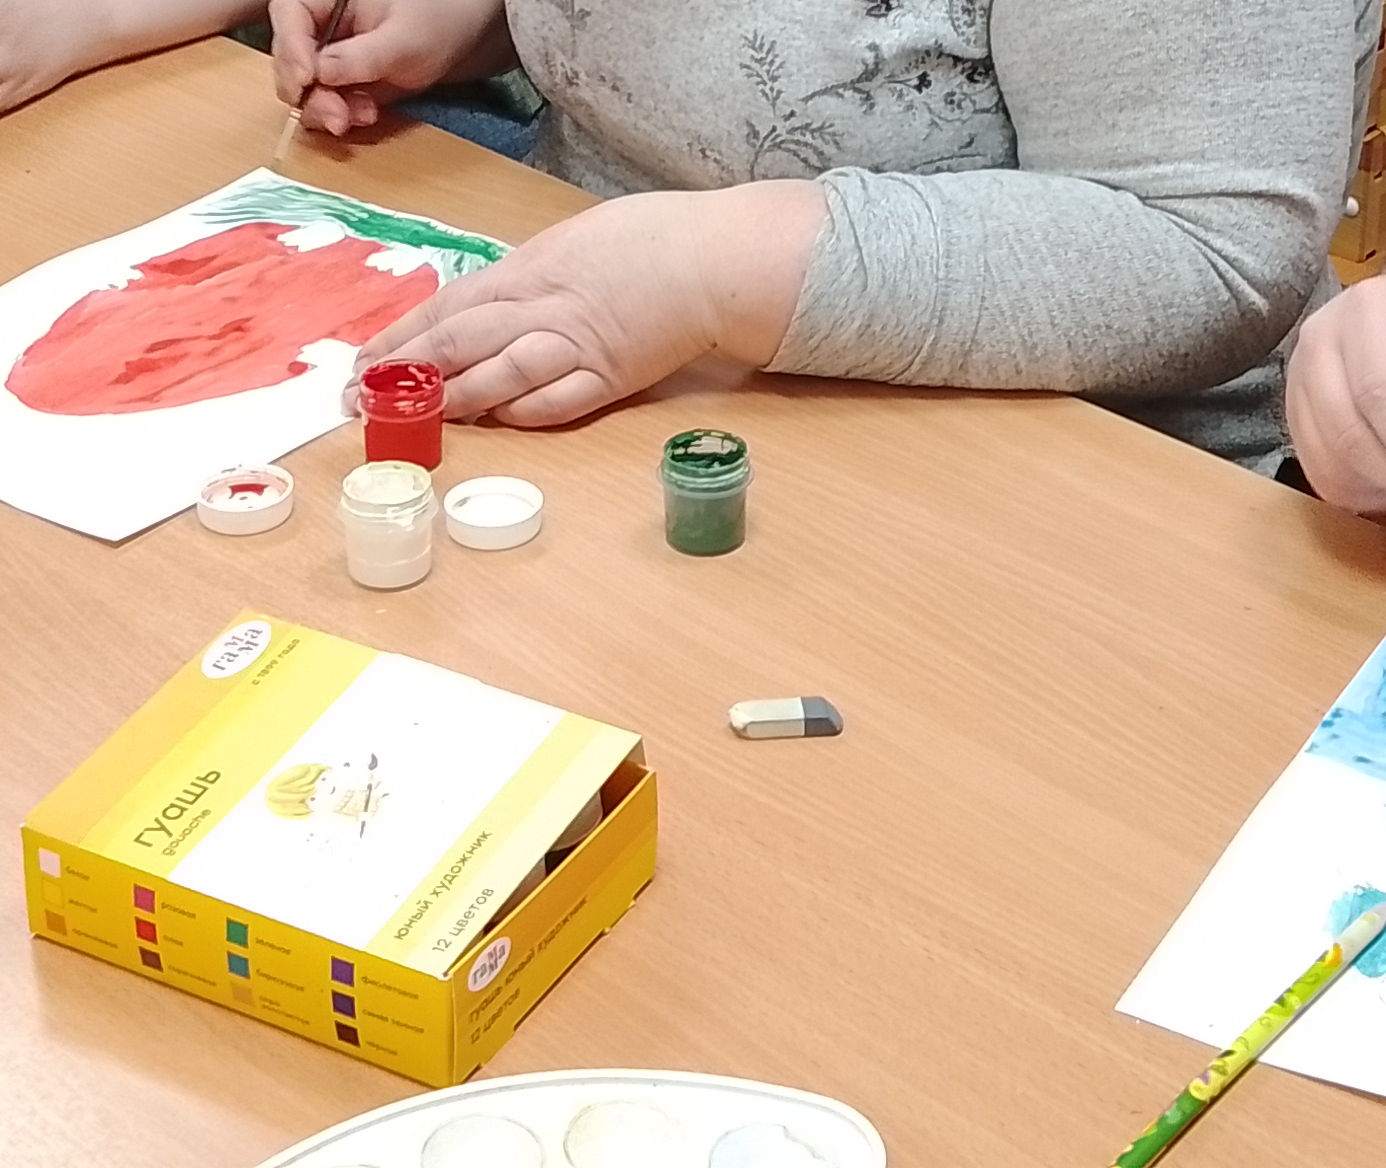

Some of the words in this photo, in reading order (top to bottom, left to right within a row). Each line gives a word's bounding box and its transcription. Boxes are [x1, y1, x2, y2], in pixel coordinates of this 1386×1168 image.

[133, 770, 221, 848] гуашь
[162, 808, 212, 857] gouache
[393, 899, 434, 941] юный
[429, 830, 493, 899] художник
[431, 938, 453, 953] 12
[448, 888, 495, 937] цветов
